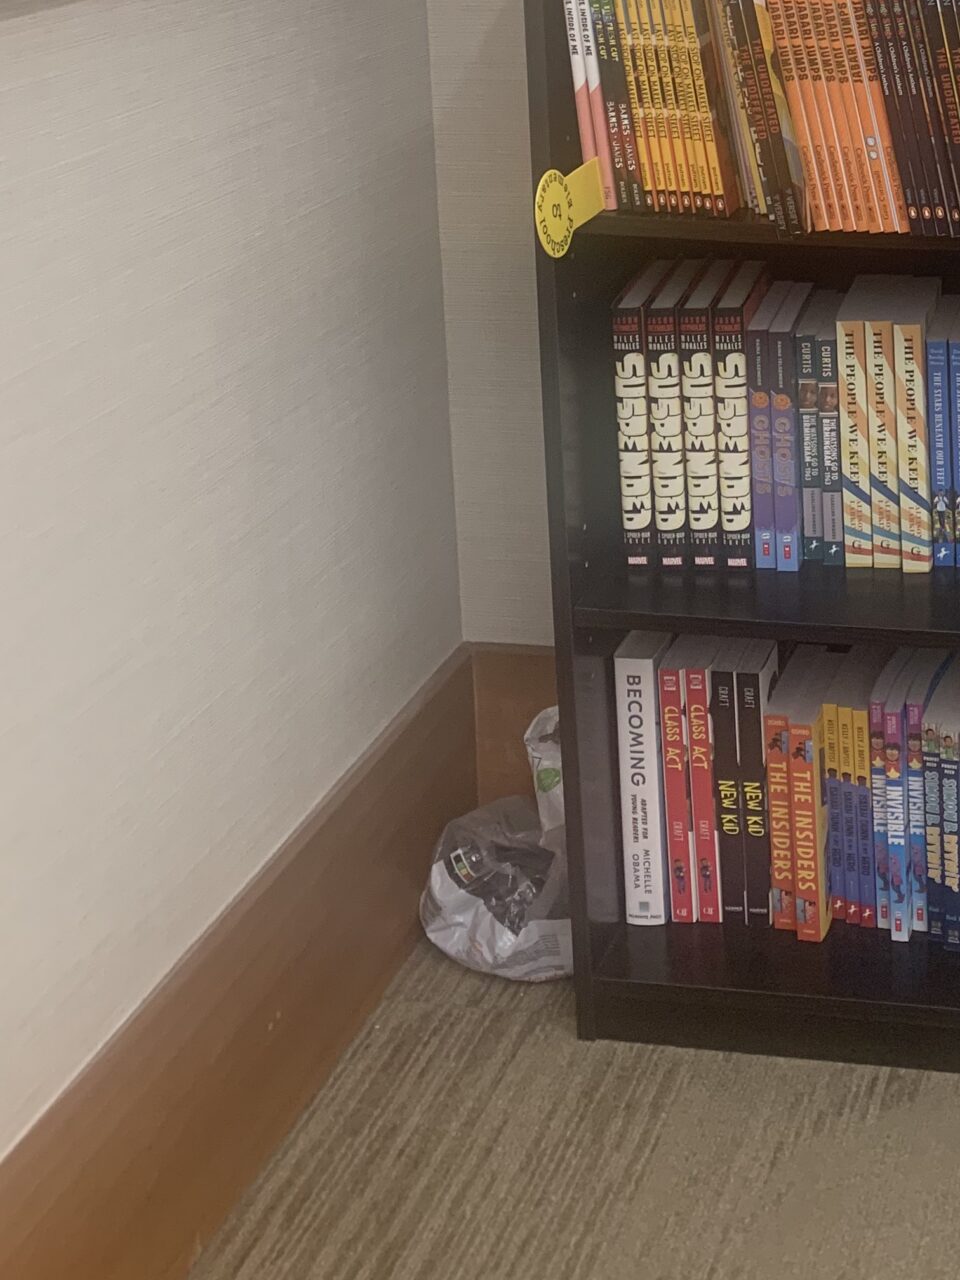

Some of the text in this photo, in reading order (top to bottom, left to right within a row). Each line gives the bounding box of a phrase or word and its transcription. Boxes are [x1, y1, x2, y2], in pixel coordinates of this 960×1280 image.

[566, 8, 575, 31] INSIDE
[569, 33, 576, 43] OF
[769, 1, 795, 82] JABARI JUMPS
[851, 1, 877, 82] JABARI JUMPS
[571, 45, 579, 55] ME
[687, 26, 714, 143] LAST STOP ON MARKET STREET
[822, 346, 832, 377] CURTIS
[845, 331, 854, 360] THE
[846, 364, 856, 419] PEOPLE
[715, 352, 750, 531] SUSPENDED
[848, 423, 858, 447] WE
[744, 687, 756, 709] CRAFT
[626, 675, 646, 788] BECOMING
[664, 706, 683, 772] CLASS ACT
[743, 781, 763, 811] NEW
[886, 786, 905, 847] INVISIBLE
[793, 771, 816, 892] THE INSIDERS
[632, 853, 641, 889] OBAMA
[643, 849, 652, 895] MICHELLE
